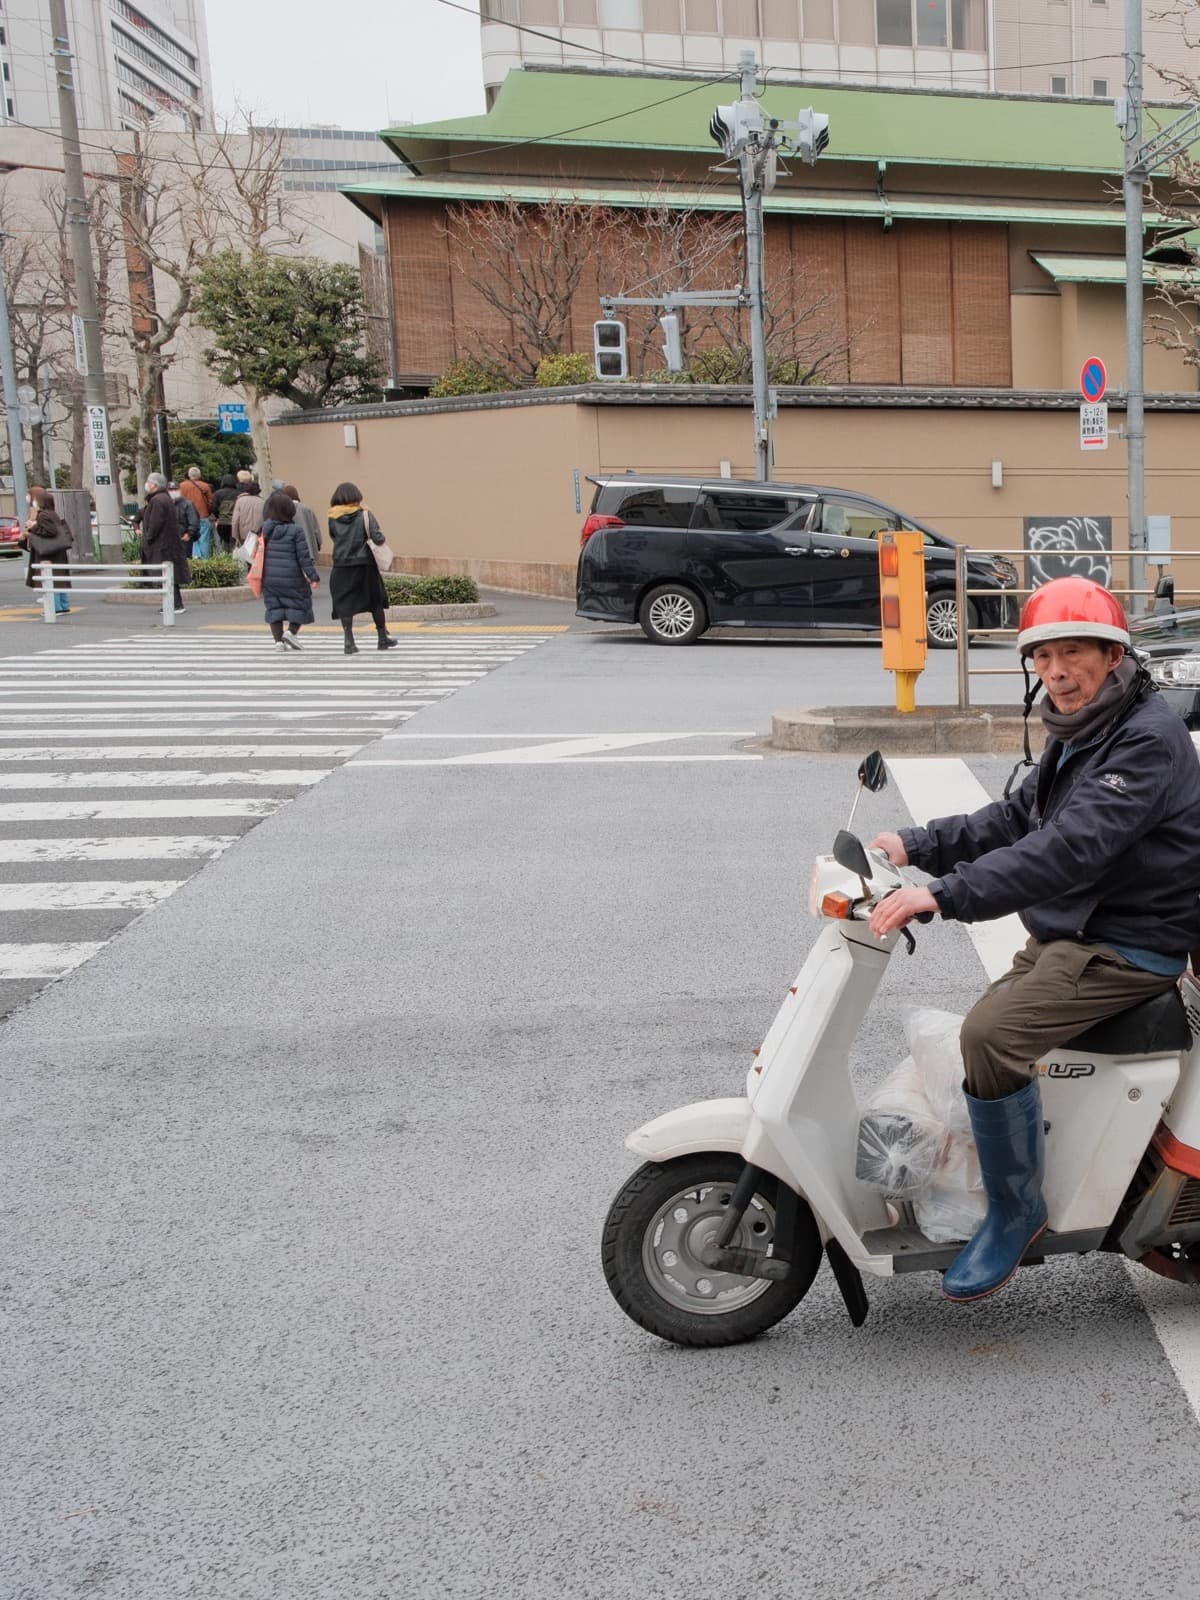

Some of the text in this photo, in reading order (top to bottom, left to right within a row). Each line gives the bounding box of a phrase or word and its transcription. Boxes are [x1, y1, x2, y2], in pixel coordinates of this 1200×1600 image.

[92, 421, 106, 459] 田辺薬局
[1048, 1063, 1096, 1079] UP
